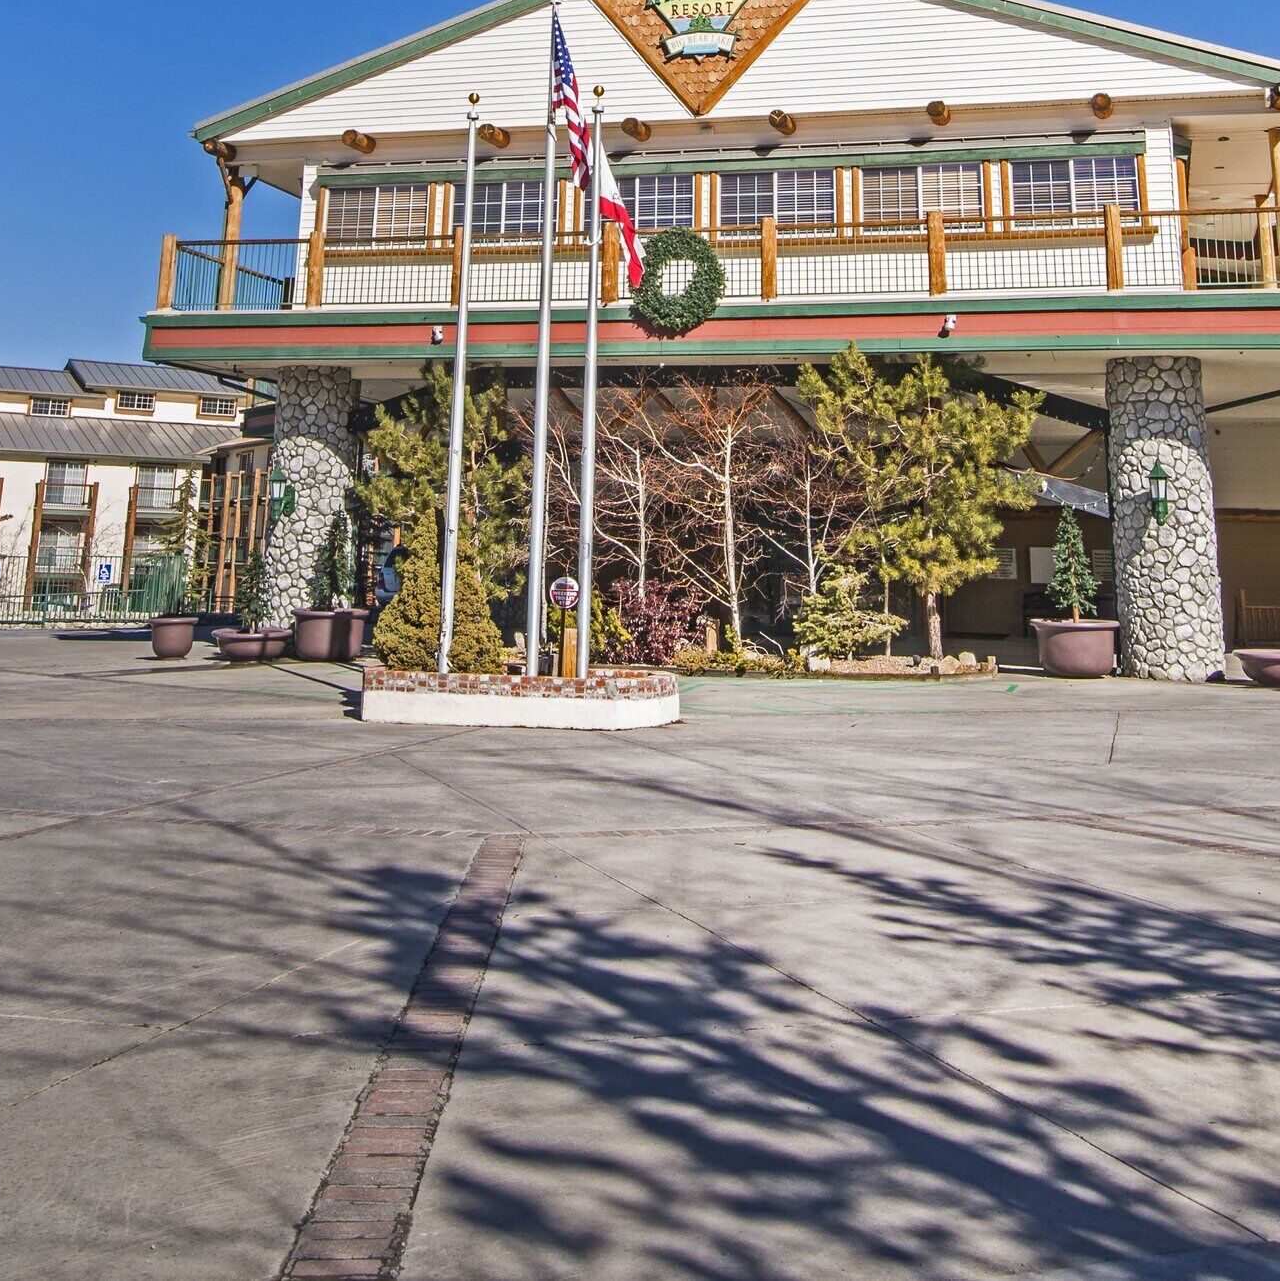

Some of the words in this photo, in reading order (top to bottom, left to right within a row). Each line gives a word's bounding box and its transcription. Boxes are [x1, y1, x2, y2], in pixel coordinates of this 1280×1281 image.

[671, 1, 734, 16] RESORT
[671, 38, 686, 50] BIG
[688, 34, 708, 44] BEAR
[711, 34, 731, 47] LAKE
